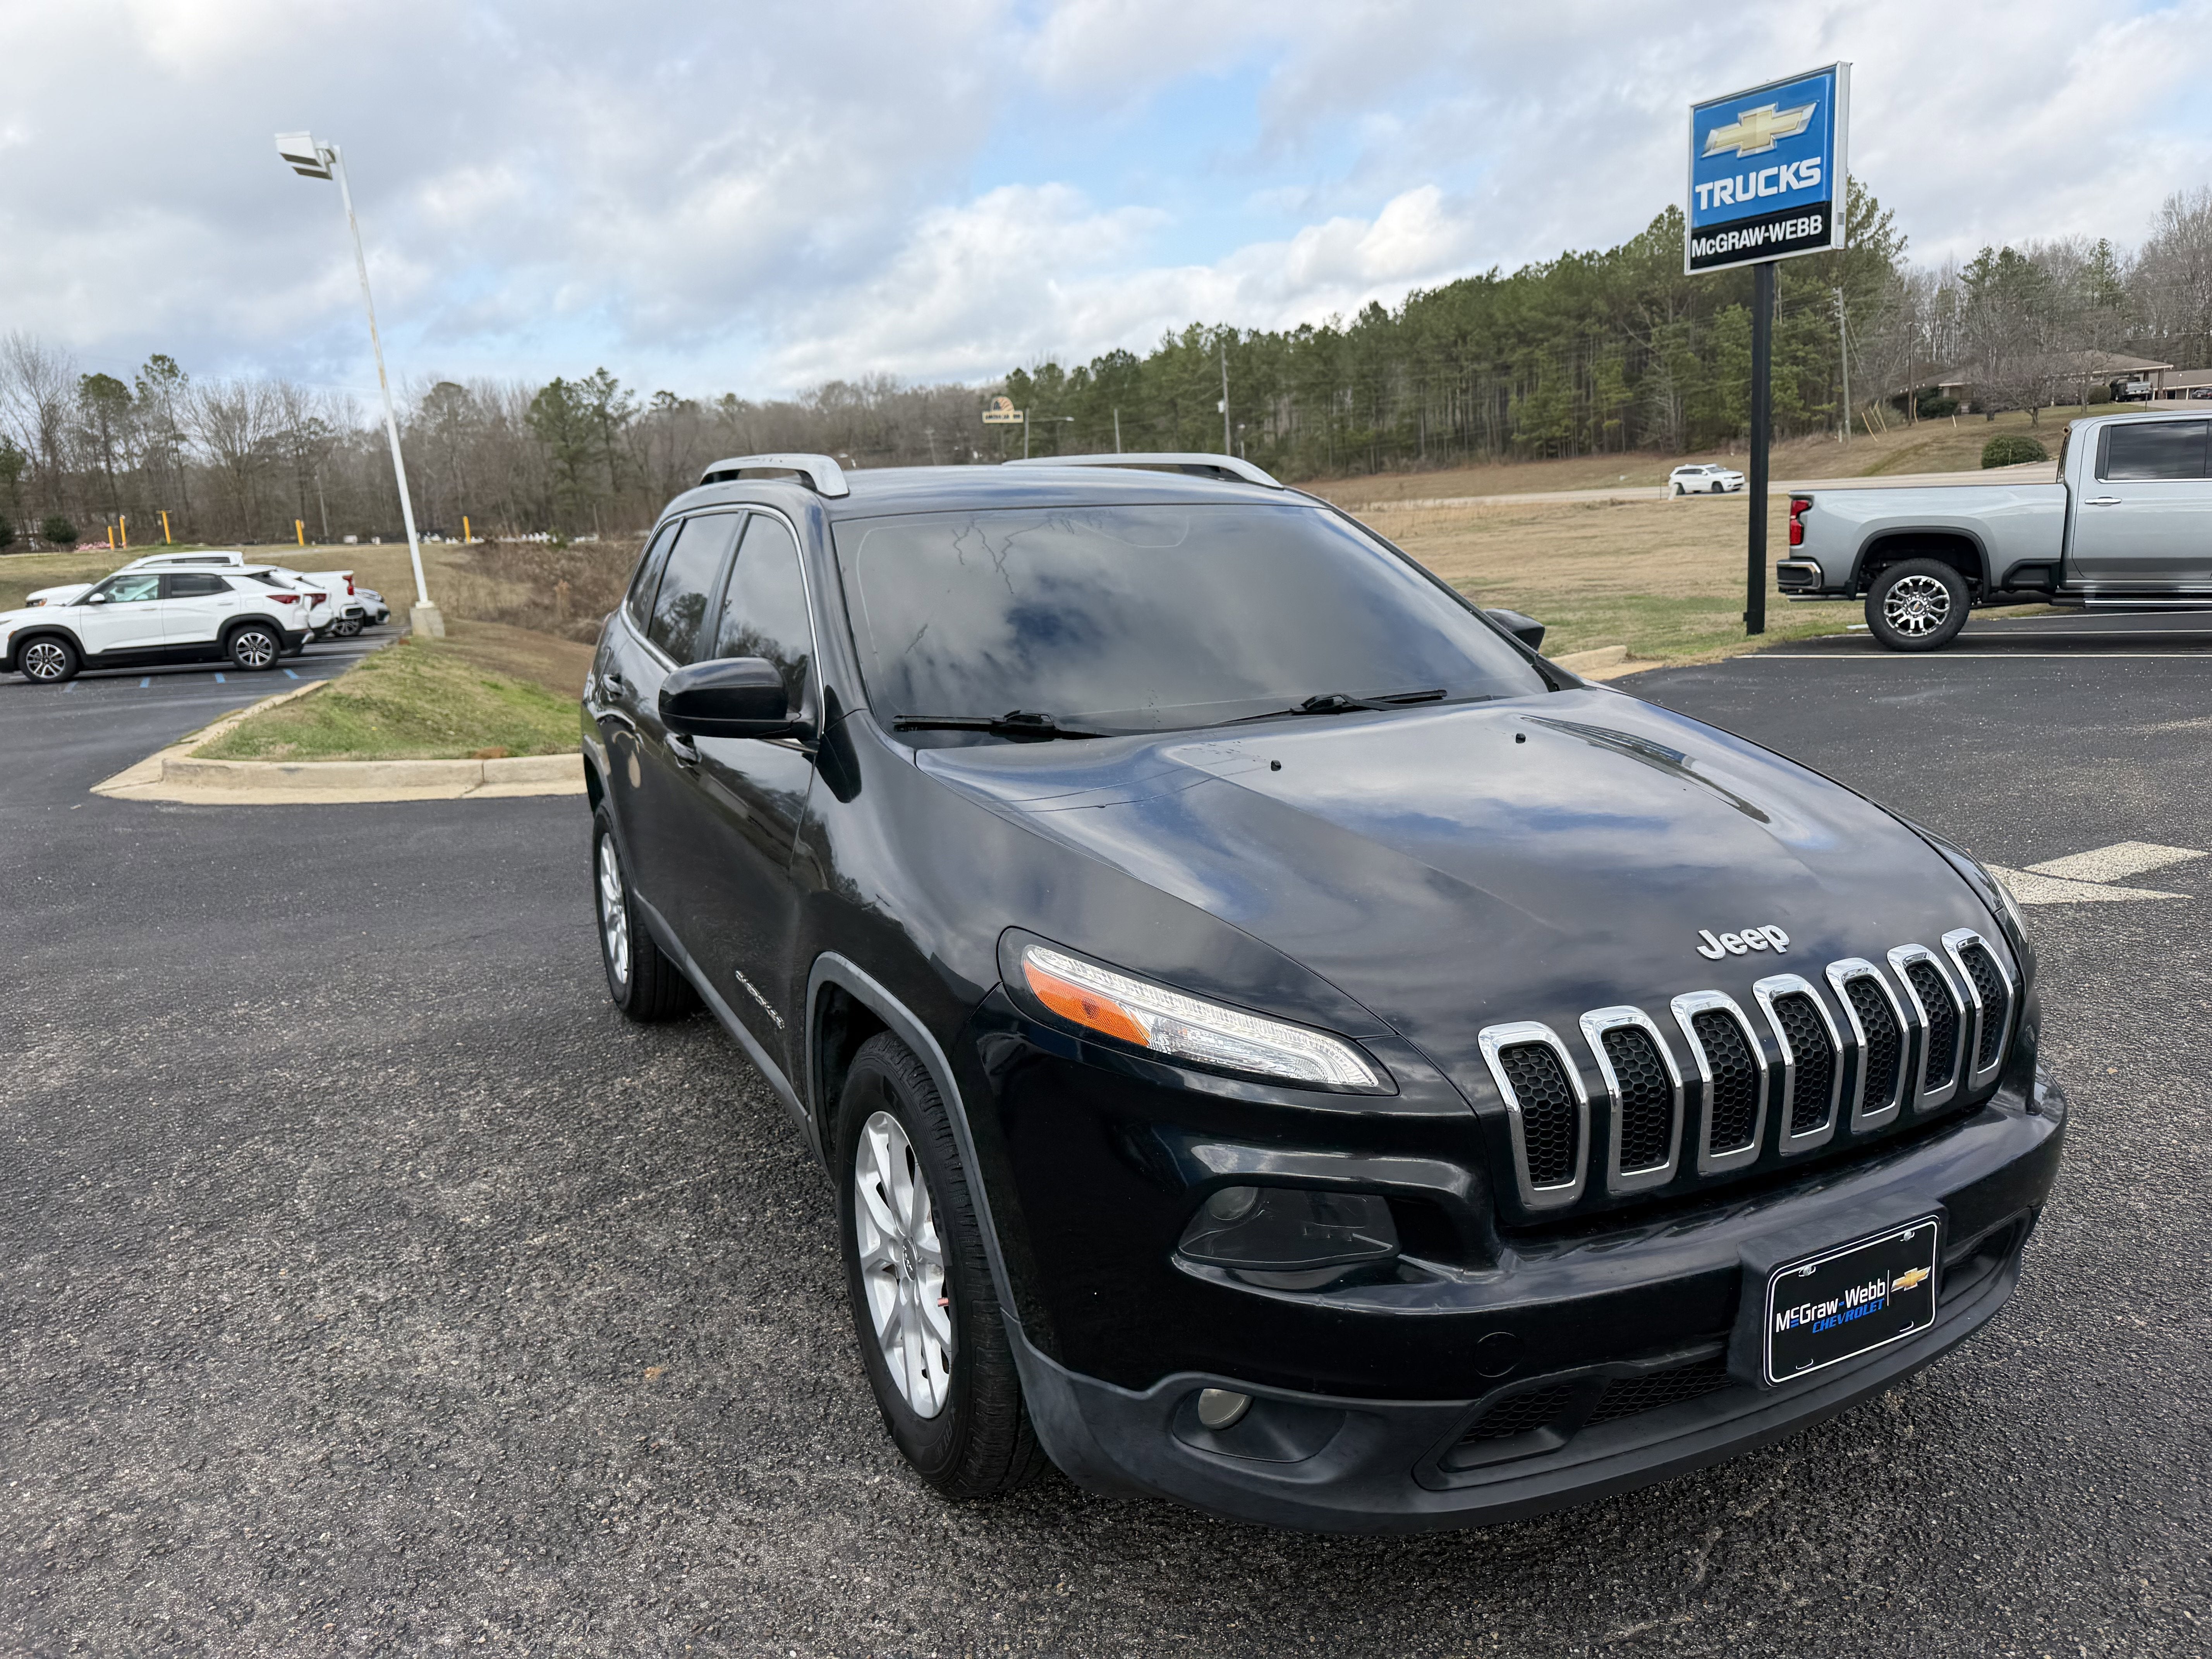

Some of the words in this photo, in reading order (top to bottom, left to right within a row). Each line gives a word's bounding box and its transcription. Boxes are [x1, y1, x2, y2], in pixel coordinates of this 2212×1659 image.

[1695, 156, 1821, 210] TRUCKS
[1692, 214, 1822, 258] McGRAW-WEBB
[1697, 925, 1790, 959] Jeep
[1776, 1278, 1885, 1333] McGraw-Webb
[1812, 1298, 1885, 1333] CHEVROLET
